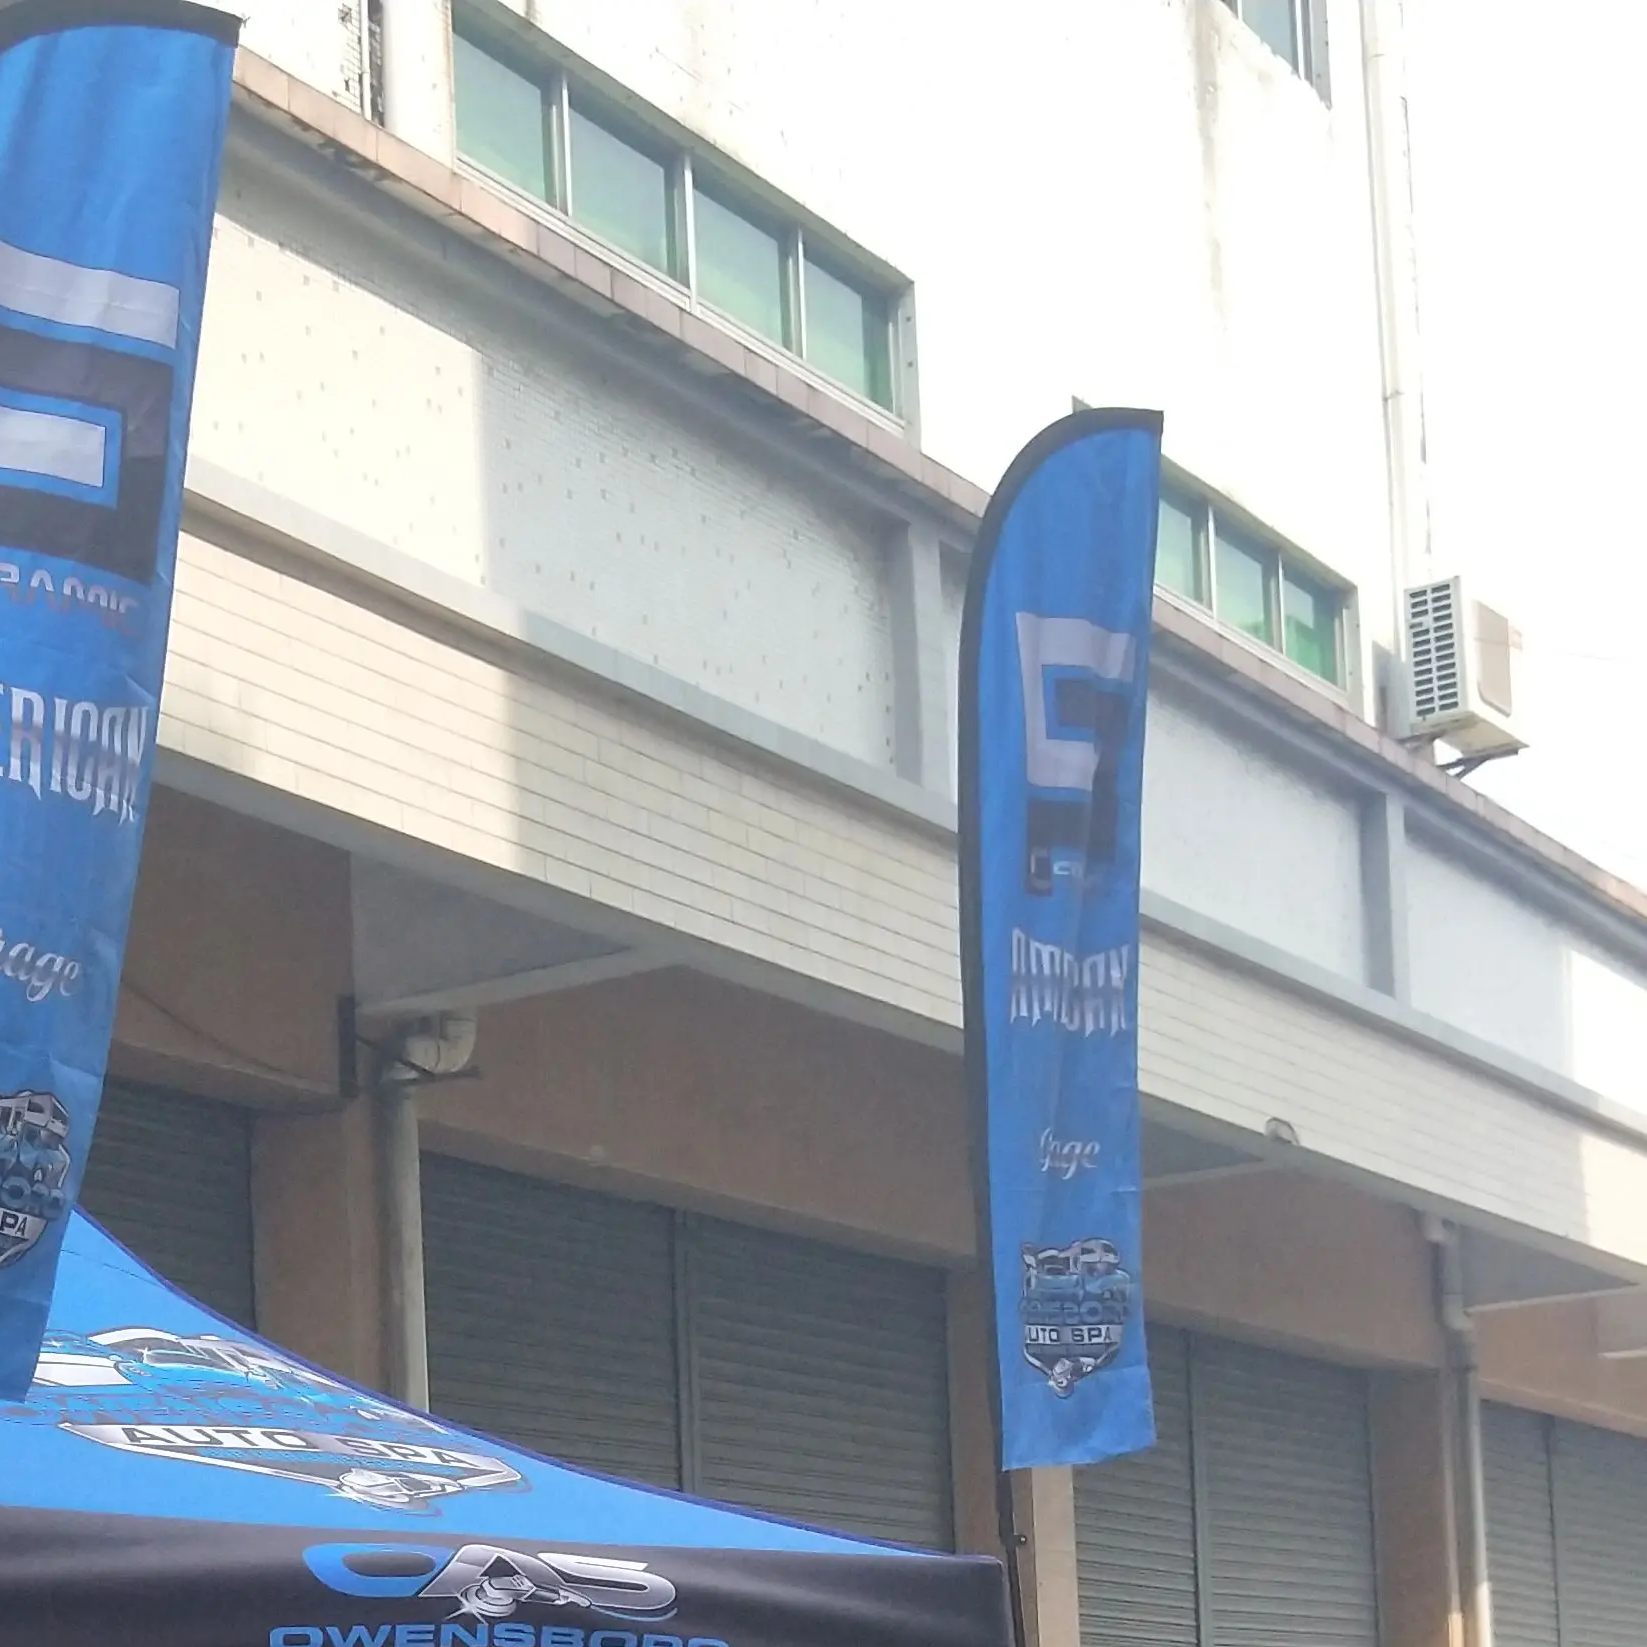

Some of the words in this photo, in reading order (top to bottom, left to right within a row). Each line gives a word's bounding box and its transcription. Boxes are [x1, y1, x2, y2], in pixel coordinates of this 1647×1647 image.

[1026, 1327, 1059, 1342] UTO
[1072, 1327, 1112, 1342] SPA
[121, 1427, 319, 1450] AUTO
[337, 1436, 482, 1470] SPA
